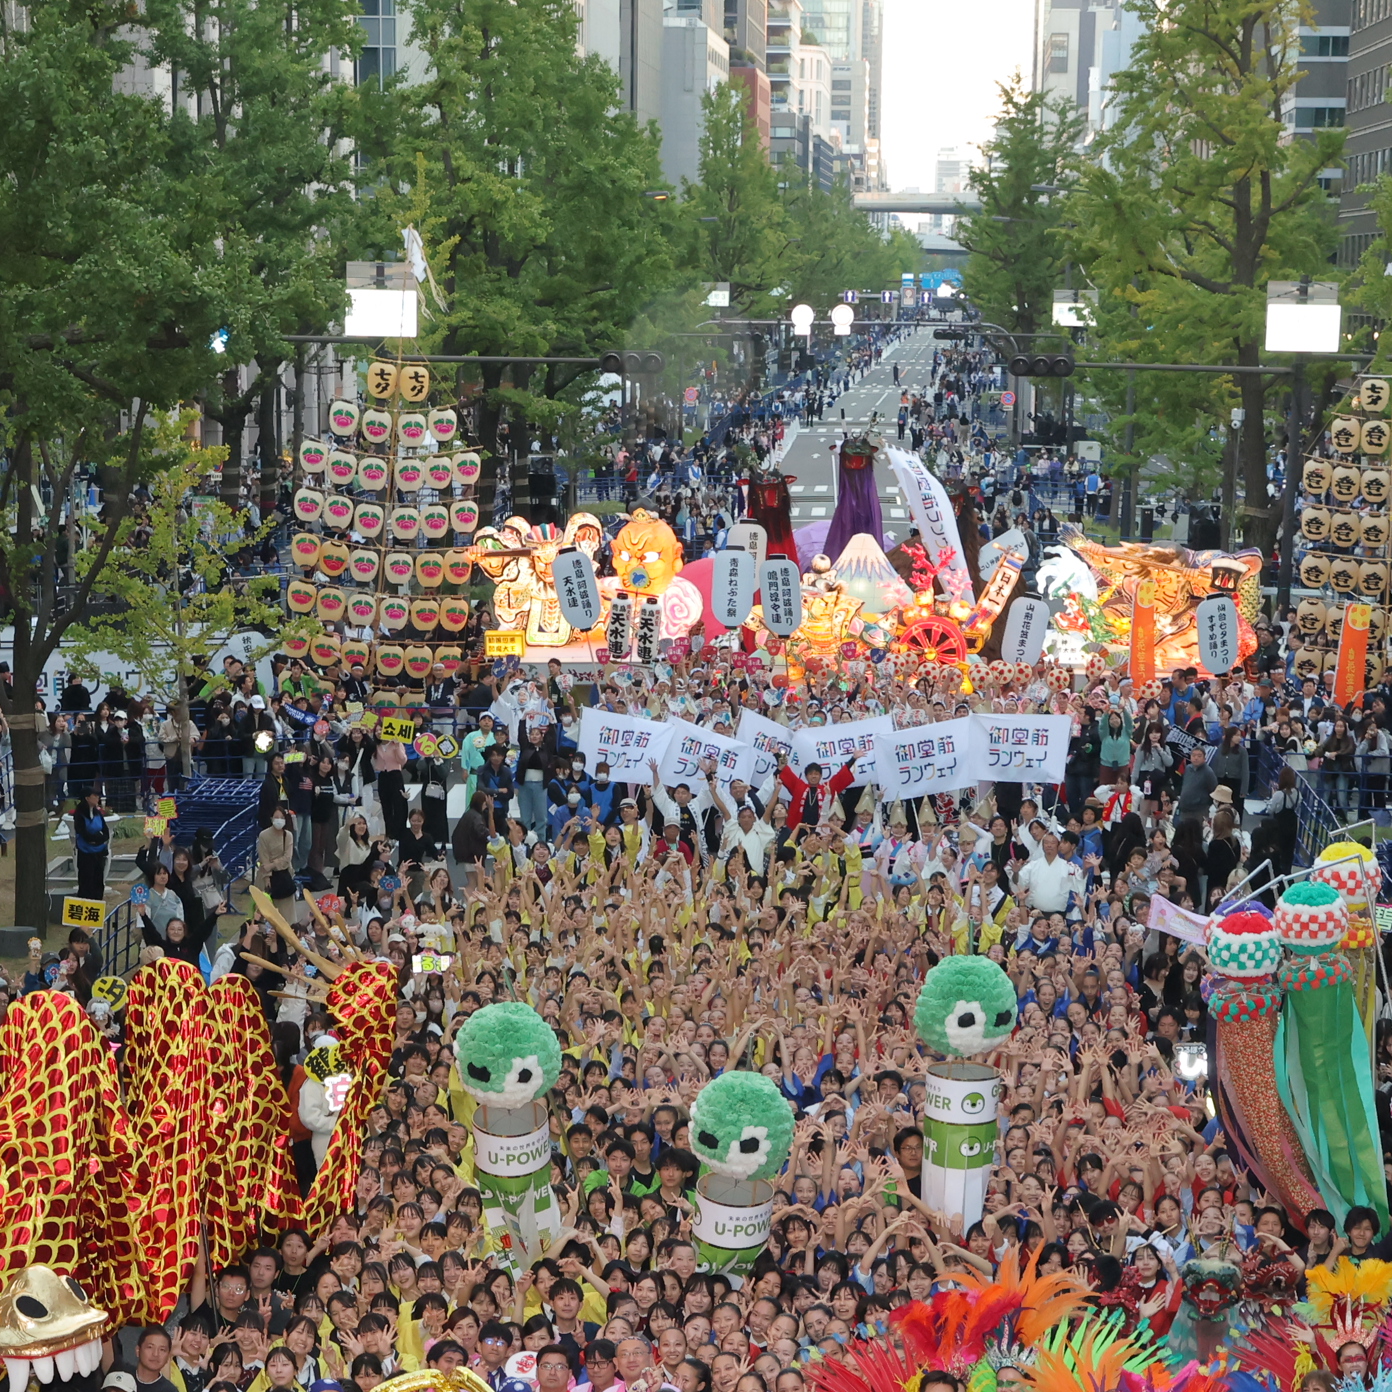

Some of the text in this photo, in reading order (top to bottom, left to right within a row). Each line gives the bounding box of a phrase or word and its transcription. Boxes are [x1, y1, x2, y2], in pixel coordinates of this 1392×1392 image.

[374, 368, 392, 395] 七夕
[408, 371, 426, 397] 七夕
[1365, 383, 1384, 406] 七夕
[562, 576, 578, 608] 天水連
[726, 558, 739, 618] 青森ねぶた祭
[599, 726, 652, 748] 御堂筋
[816, 733, 874, 759] 御堂筋
[989, 725, 1049, 746] 御堂筋
[597, 749, 644, 769] ランウェイ
[681, 736, 739, 770] 御堂筋
[894, 735, 955, 763] 御堂筋
[989, 748, 1047, 769] ランウェイ
[820, 760, 876, 780] ランェイ
[898, 757, 957, 785] ランウェイ
[68, 904, 101, 922] 碧海
[488, 1141, 551, 1167] U-POWE
[714, 1219, 771, 1237] U-POW
